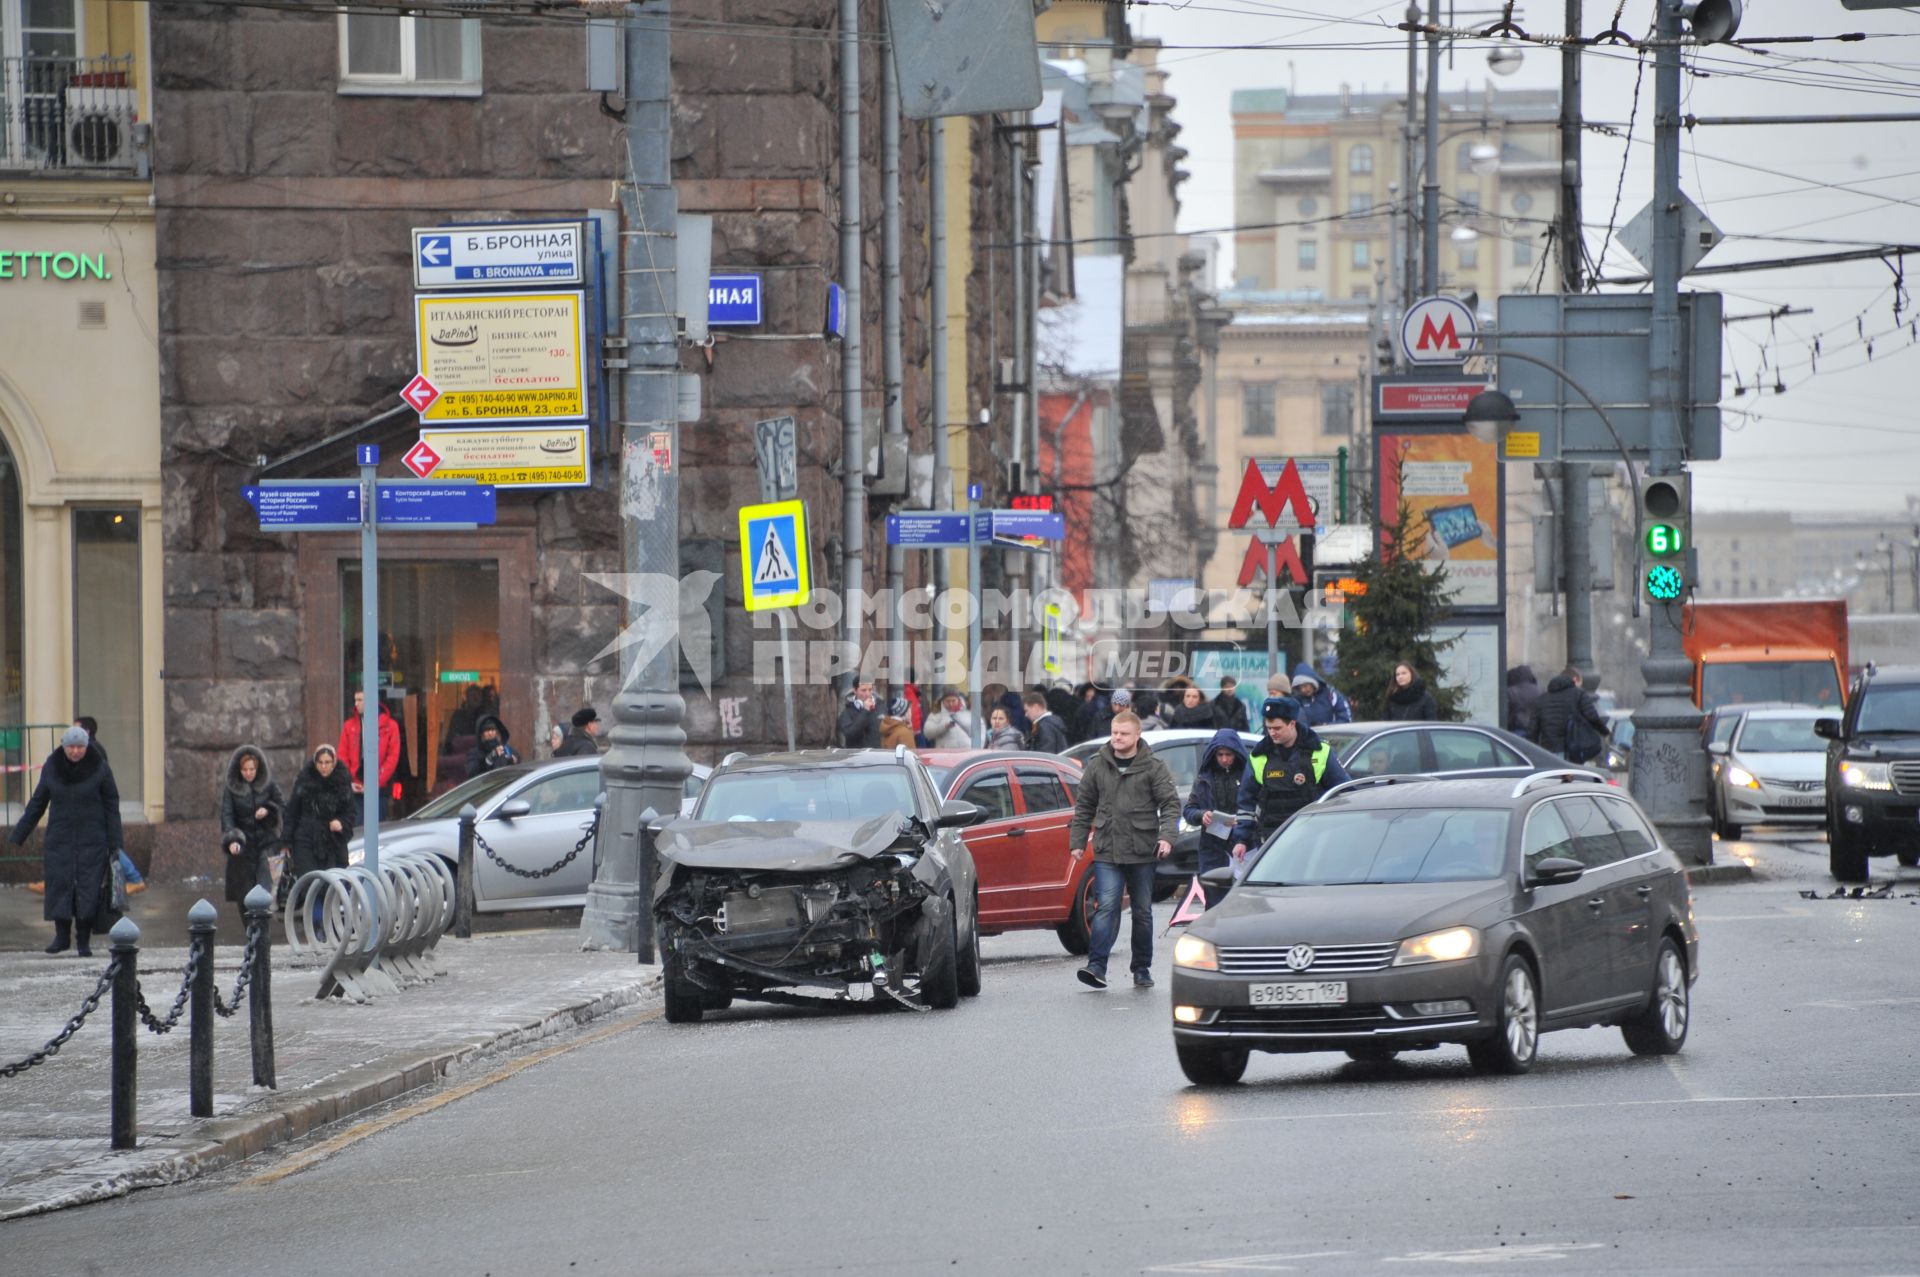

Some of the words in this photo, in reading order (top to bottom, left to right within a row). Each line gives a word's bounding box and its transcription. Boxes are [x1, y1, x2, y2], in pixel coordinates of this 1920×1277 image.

[467, 236, 483, 251] Б.
[487, 233, 572, 250] БРОННАЯ
[537, 249, 573, 261] улица
[473, 267, 484, 278] B.
[486, 265, 544, 277] BRONNAYA
[549, 267, 572, 276] street
[430, 307, 511, 321] ИТАЛЬЯНСКИЙ
[513, 306, 569, 319] РЕСТОРАН
[438, 327, 470, 340] DaPino
[491, 330, 558, 340] БИЗНЕС-ЛАНЧ
[1416, 312, 1461, 351] М
[549, 348, 565, 357] 130
[494, 375, 560, 384] бесплатно
[458, 394, 478, 405] (495)
[479, 393, 516, 404] 740-40-90
[518, 391, 578, 402] WWW.DAPINO.RU
[1408, 393, 1469, 402] ПУШКИНСКАЯ
[546, 438, 570, 448] DaPino
[463, 452, 515, 460] бесплатно
[529, 471, 548, 482] (495)
[549, 470, 583, 480] 740-40-90
[1652, 526, 1680, 551] 61
[1255, 985, 1314, 1002] В985СТ
[1319, 983, 1342, 996] 197
